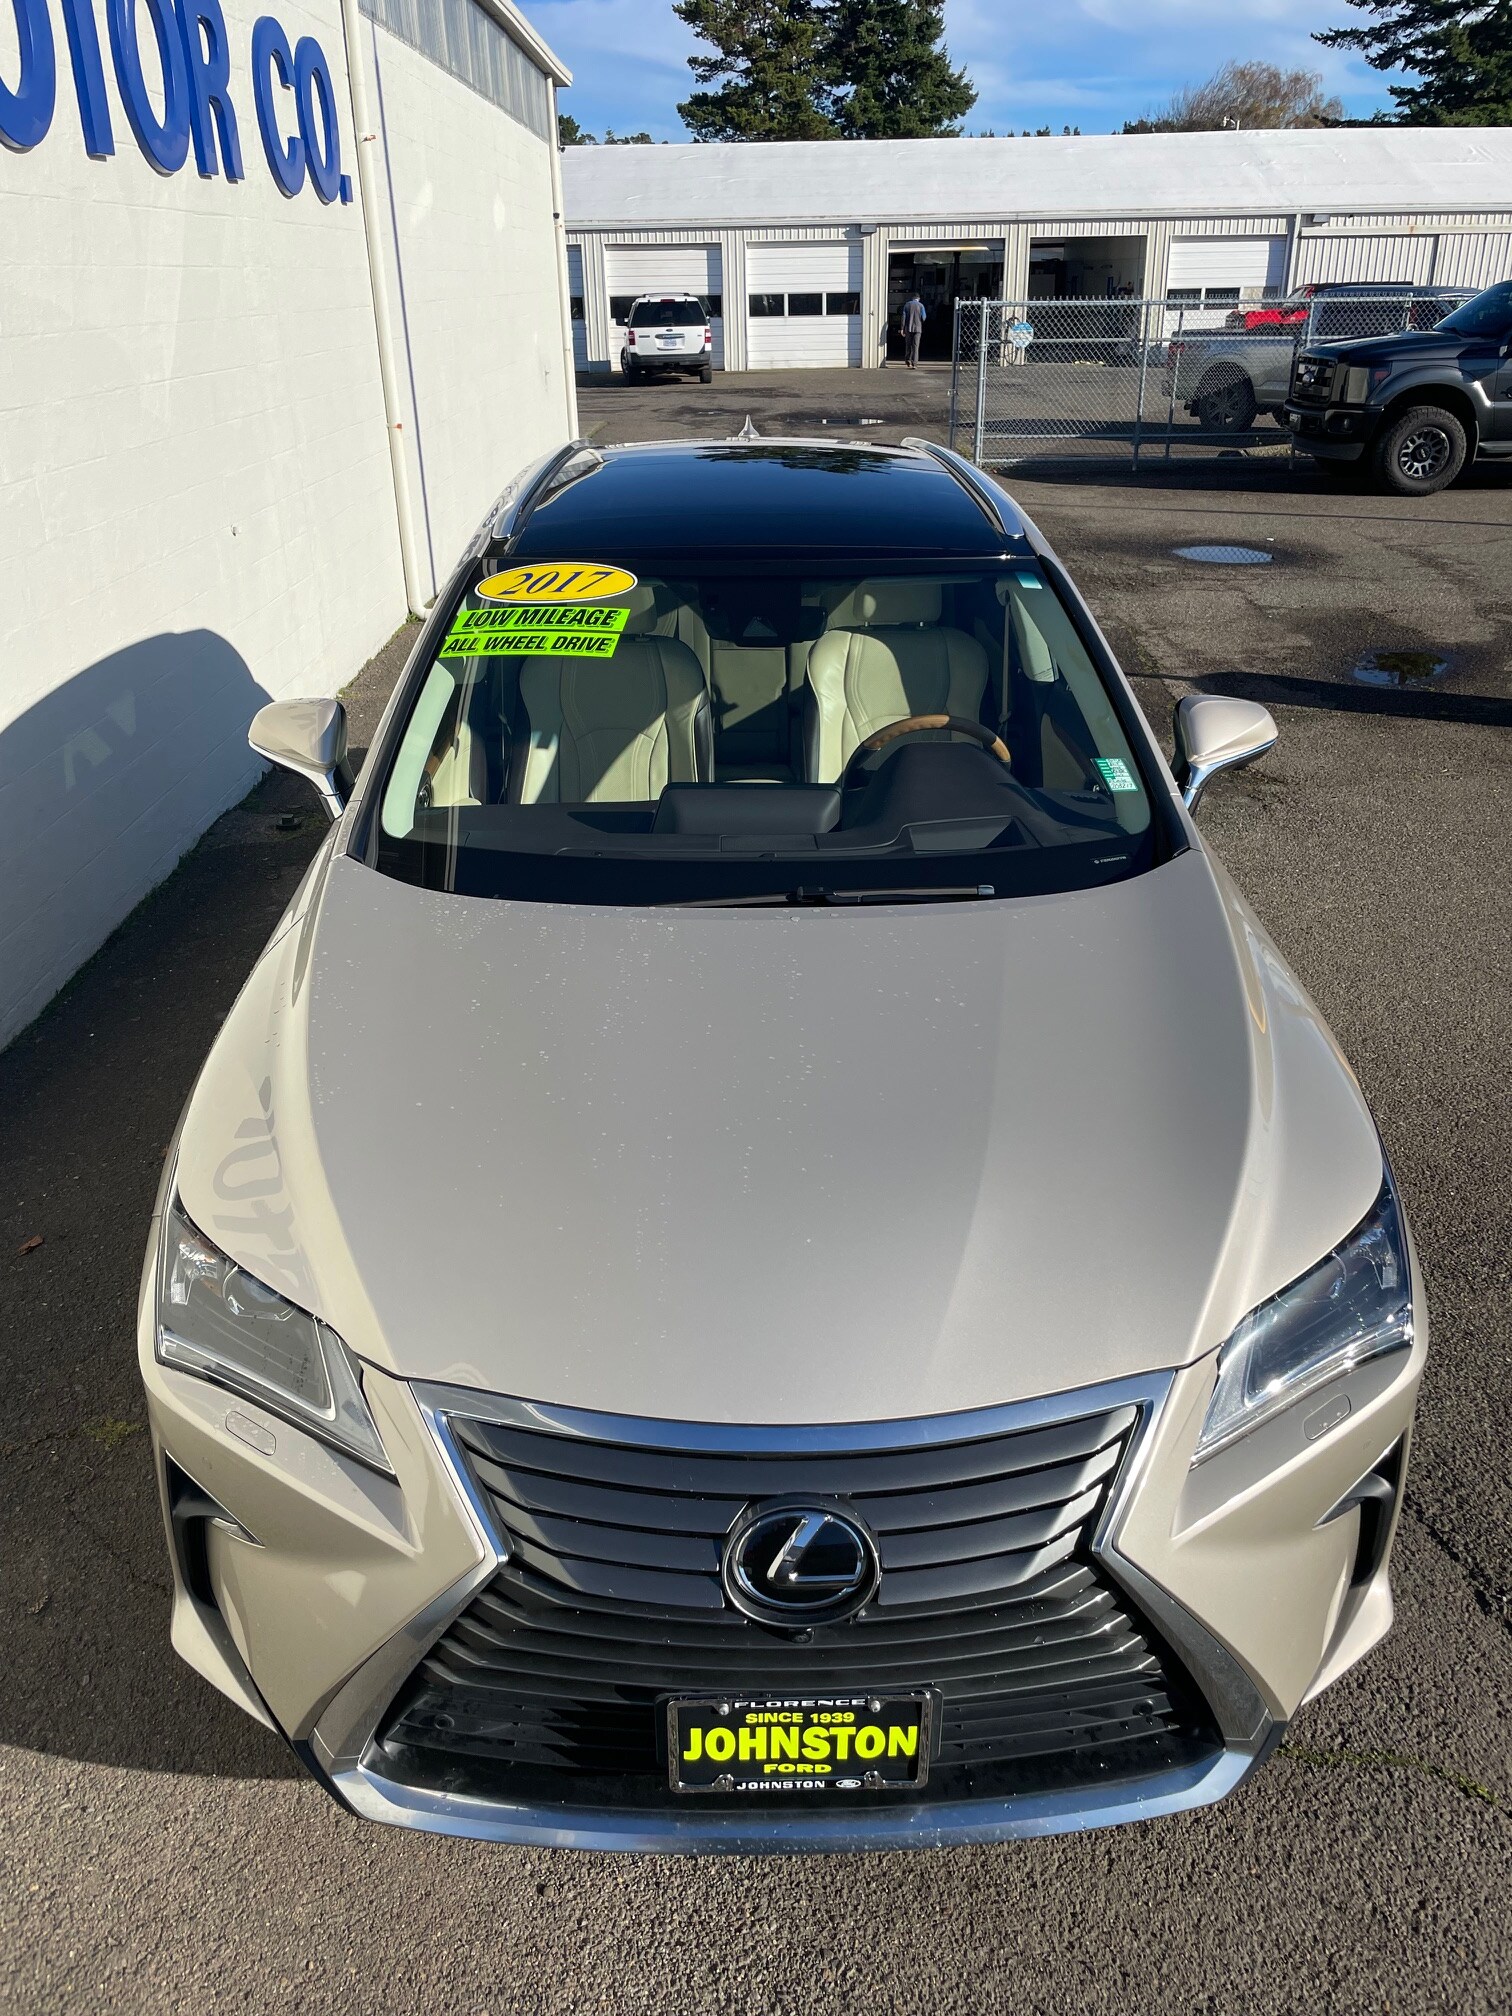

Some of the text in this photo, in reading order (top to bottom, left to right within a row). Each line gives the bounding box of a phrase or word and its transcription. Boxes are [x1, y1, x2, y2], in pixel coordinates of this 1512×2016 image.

[252, 15, 353, 206] CO.
[497, 570, 615, 596] 2017
[462, 608, 620, 628] LOW MILEAGE
[443, 635, 613, 653] ALL WHEEL DRIVE
[734, 1698, 866, 1708] FLORENCE
[745, 1712, 855, 1724] SINCE 1939
[683, 1726, 918, 1761] JOHNSTON
[763, 1763, 832, 1774] FORD
[736, 1780, 825, 1790] JOHNSTON
